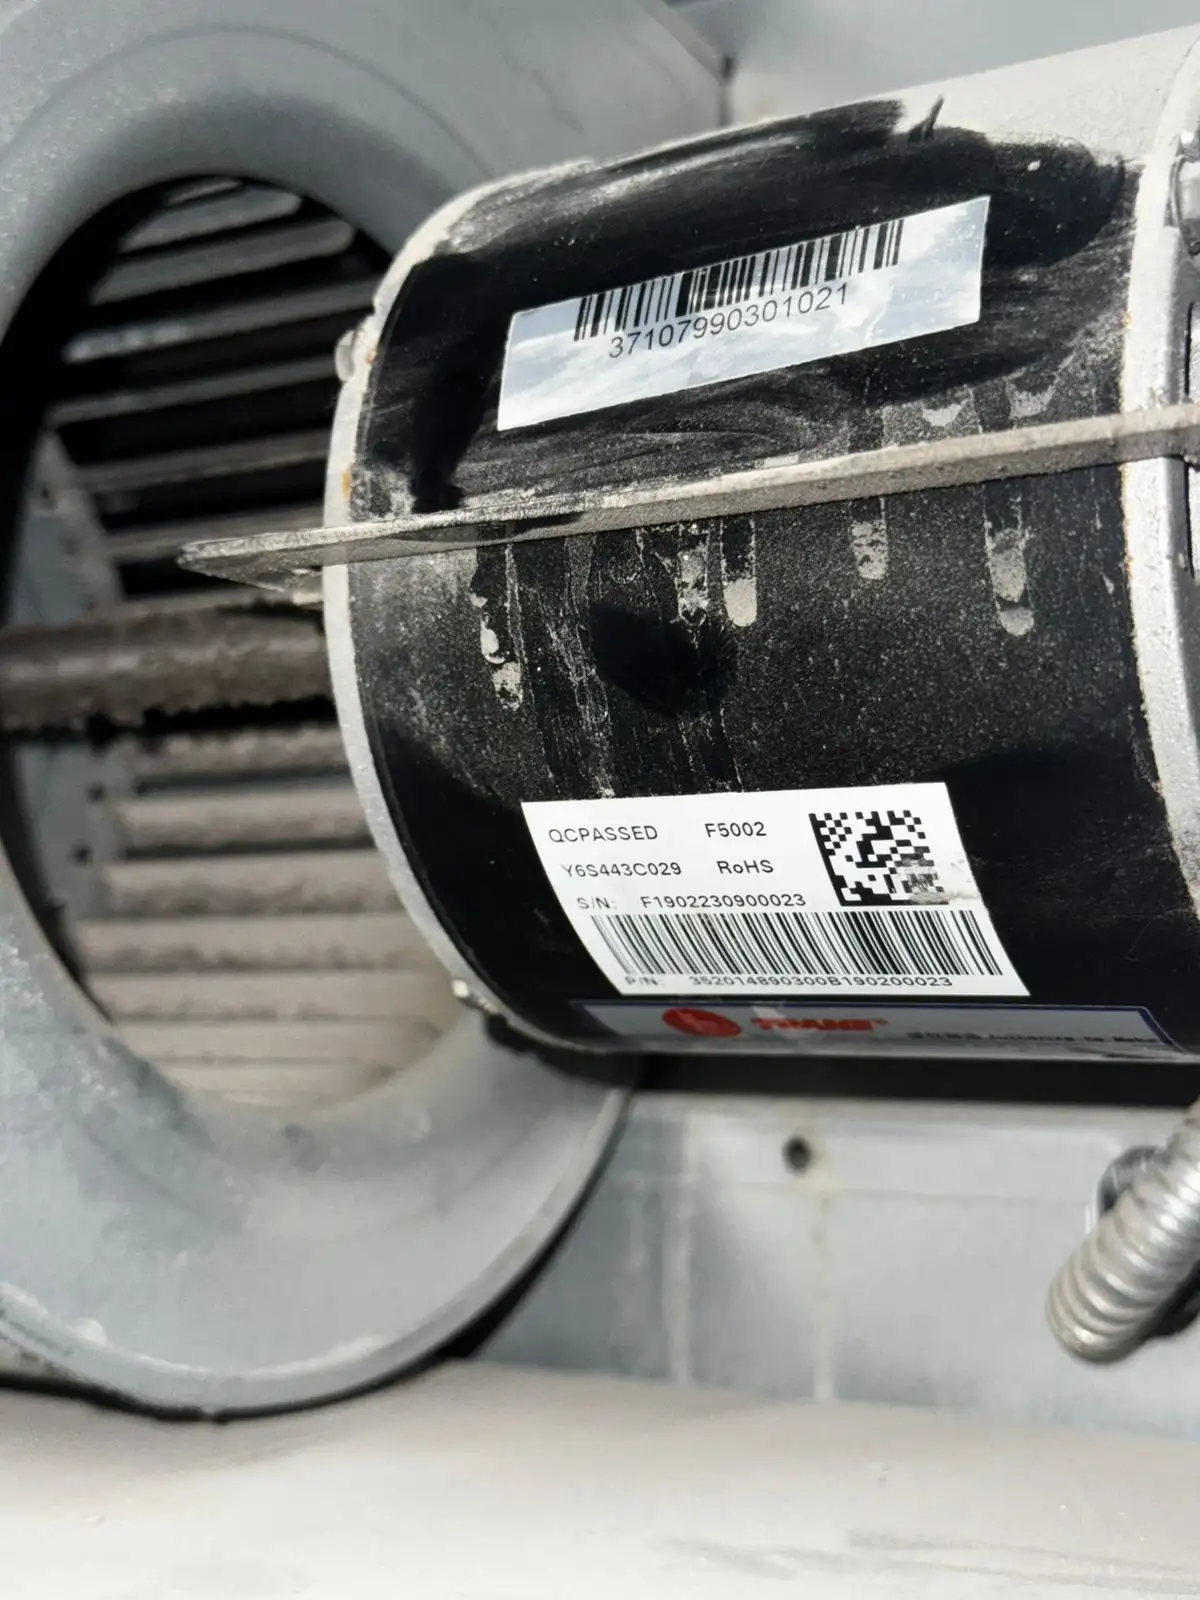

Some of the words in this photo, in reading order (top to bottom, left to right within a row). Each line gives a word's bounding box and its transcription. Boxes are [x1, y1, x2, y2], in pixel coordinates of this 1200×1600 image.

[608, 284, 848, 359] 37107990301021
[548, 824, 659, 844] QCPASSED
[704, 820, 768, 839] F5002
[560, 860, 682, 879] Y6S443C029
[716, 858, 775, 877] RoHS
[640, 892, 807, 910] F1902230900023
